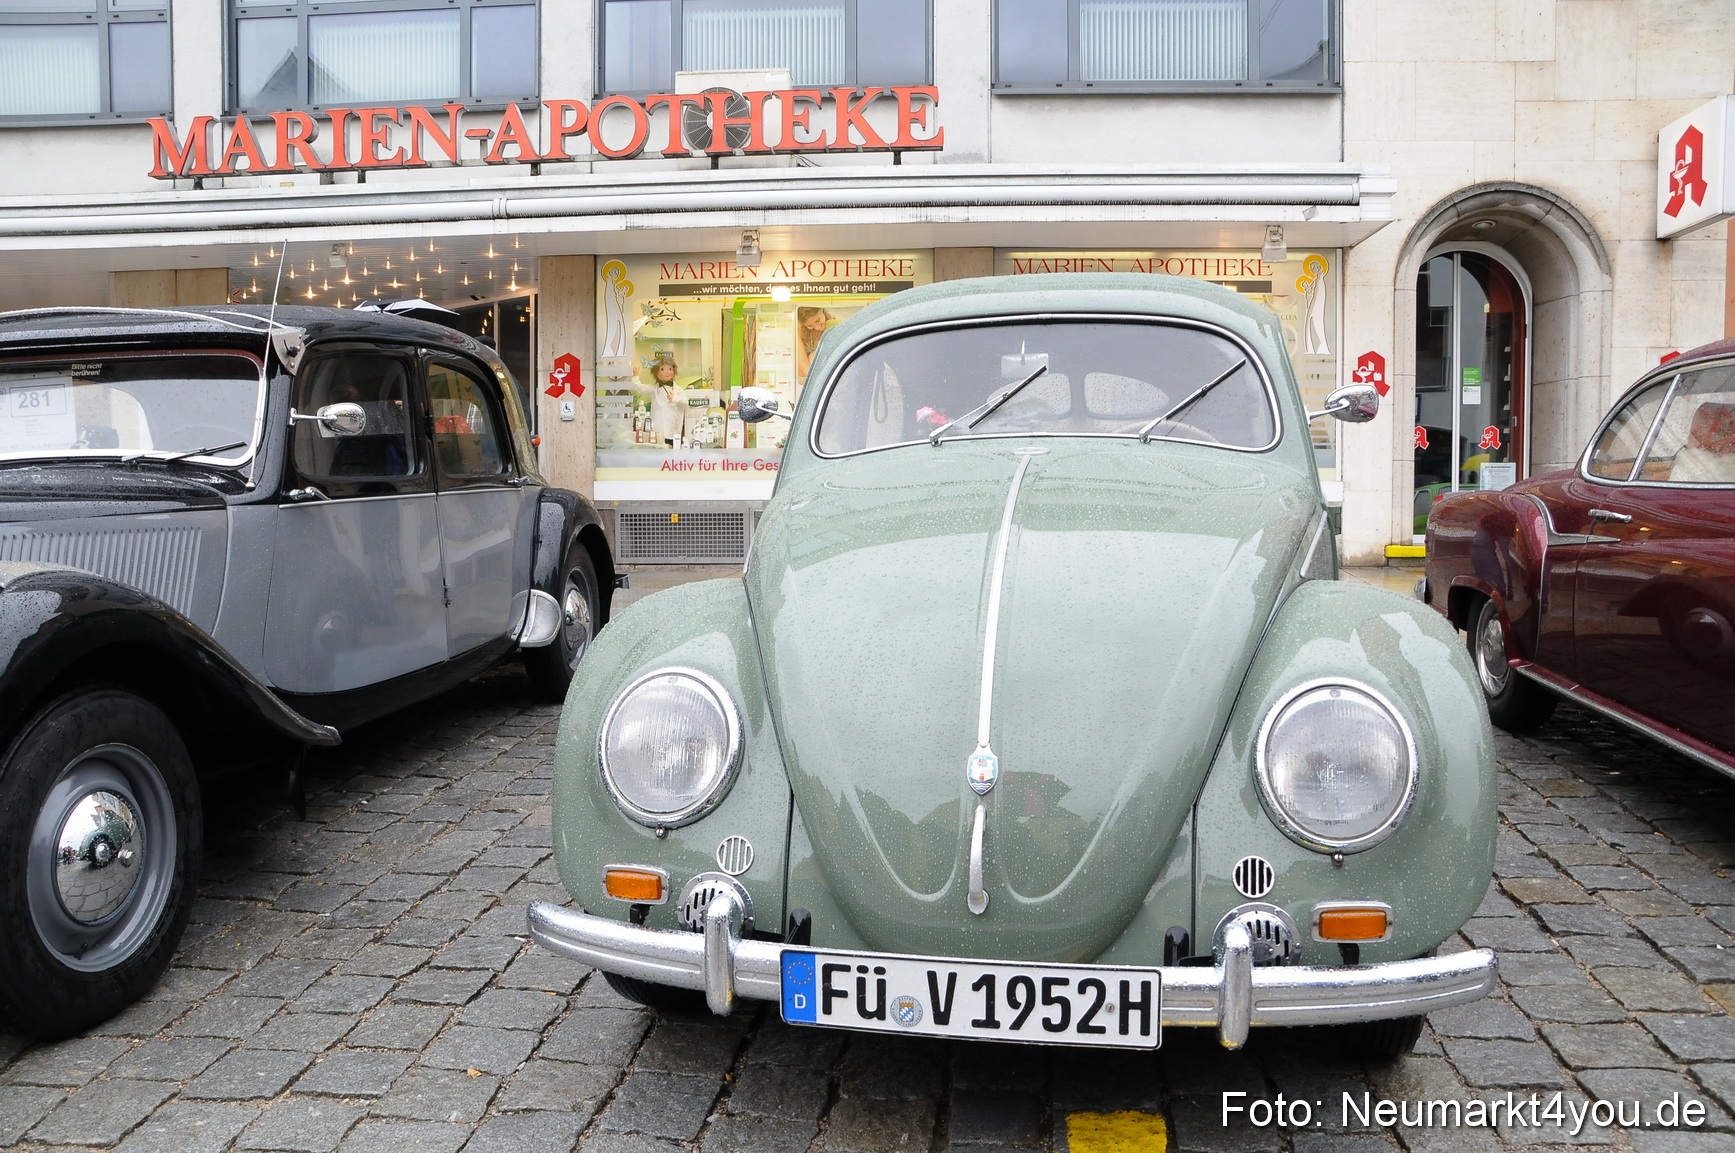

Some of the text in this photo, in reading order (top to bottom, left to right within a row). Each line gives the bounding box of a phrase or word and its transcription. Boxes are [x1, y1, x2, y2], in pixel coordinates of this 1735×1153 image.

[146, 86, 943, 178] MARIEN-APOTHEKE
[660, 259, 915, 280] MARIEN APOTHEKE
[1013, 257, 1274, 277] MARIEN APOTHEKE
[720, 284, 763, 295] möchten,
[803, 283, 831, 293] Ihnen
[833, 284, 850, 295] gut
[851, 283, 876, 295] geht!
[18, 390, 51, 409] 281
[661, 459, 694, 471] Aktiv
[698, 459, 718, 471] für
[722, 459, 748, 471] Ihre
[821, 962, 887, 1021] FÜ
